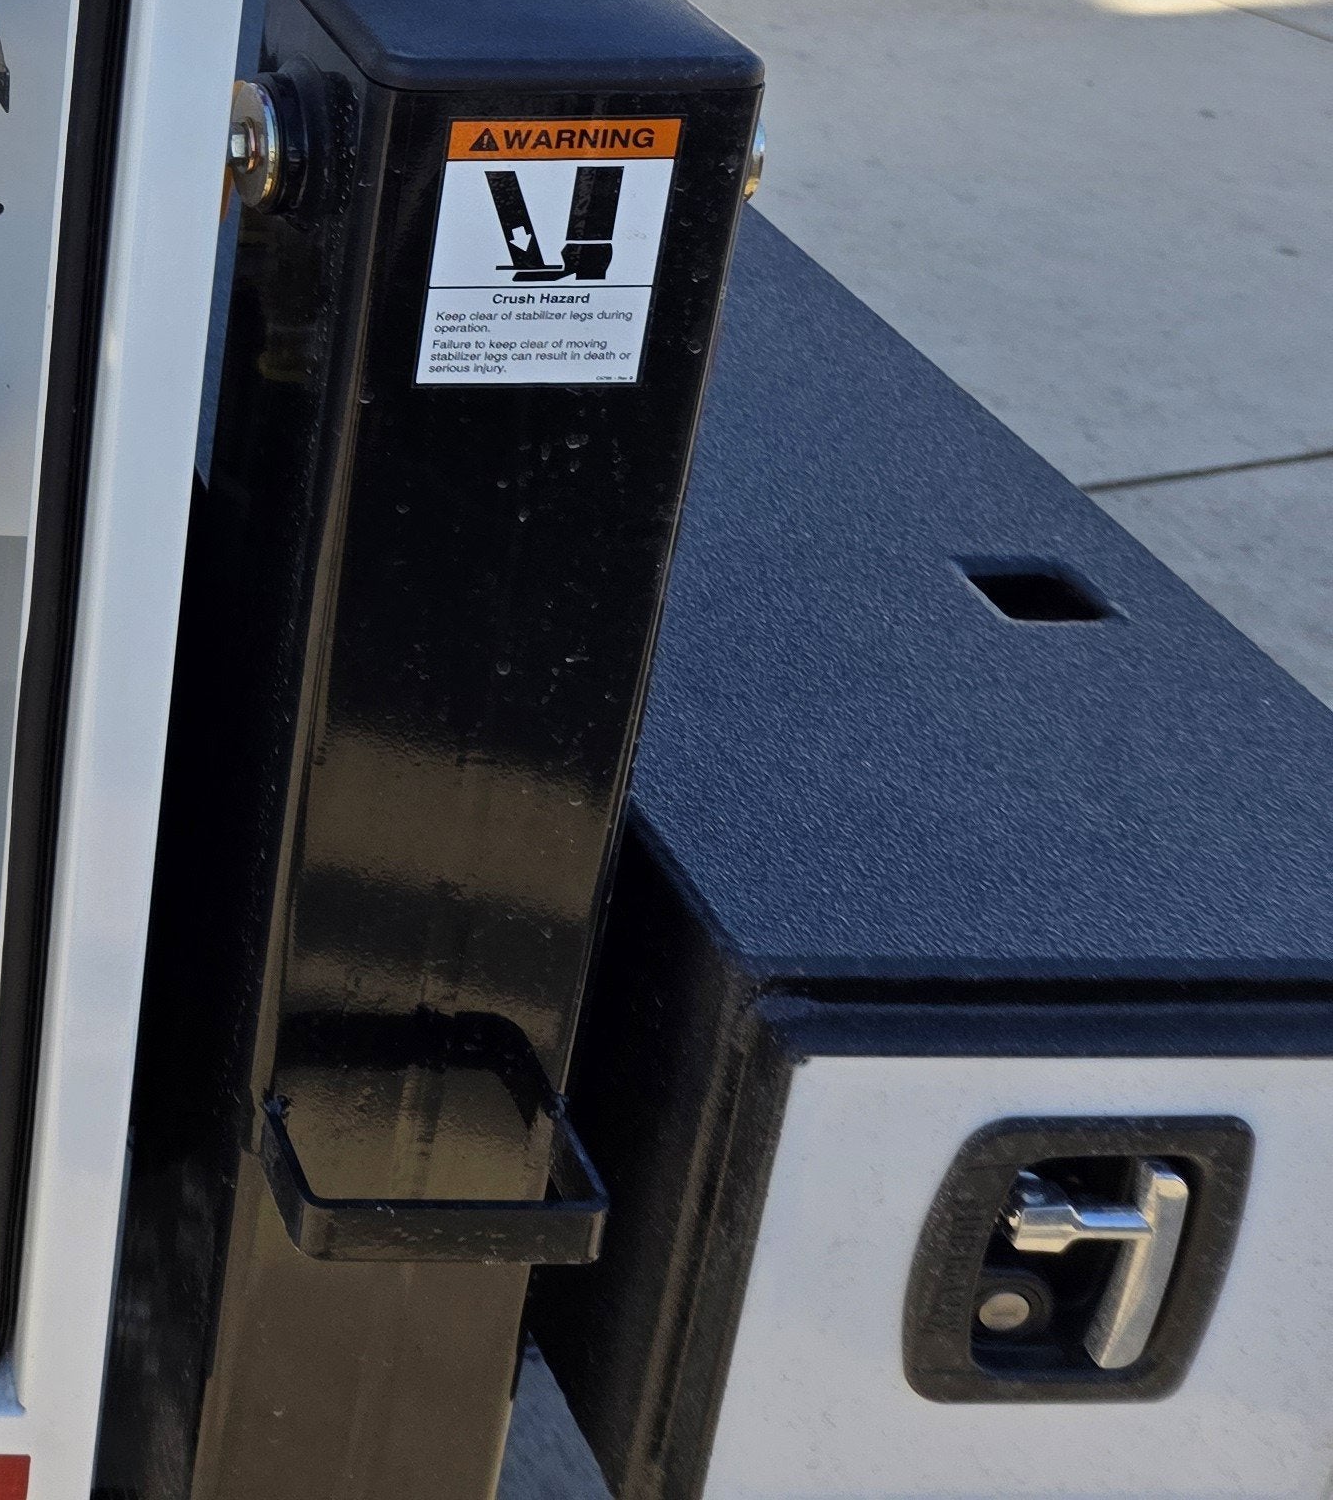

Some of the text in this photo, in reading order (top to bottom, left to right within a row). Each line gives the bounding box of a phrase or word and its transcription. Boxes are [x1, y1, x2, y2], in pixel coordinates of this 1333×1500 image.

[503, 128, 655, 150] WARNING
[492, 292, 590, 304] Crush Hazard
[436, 309, 633, 322] Keep clear of stabilizer legs during
[434, 322, 491, 334] operation.
[432, 338, 608, 350] Failure to keep clear of moving
[430, 350, 632, 363] stabilizer legs can result in death or
[428, 363, 507, 374] serious injury.
